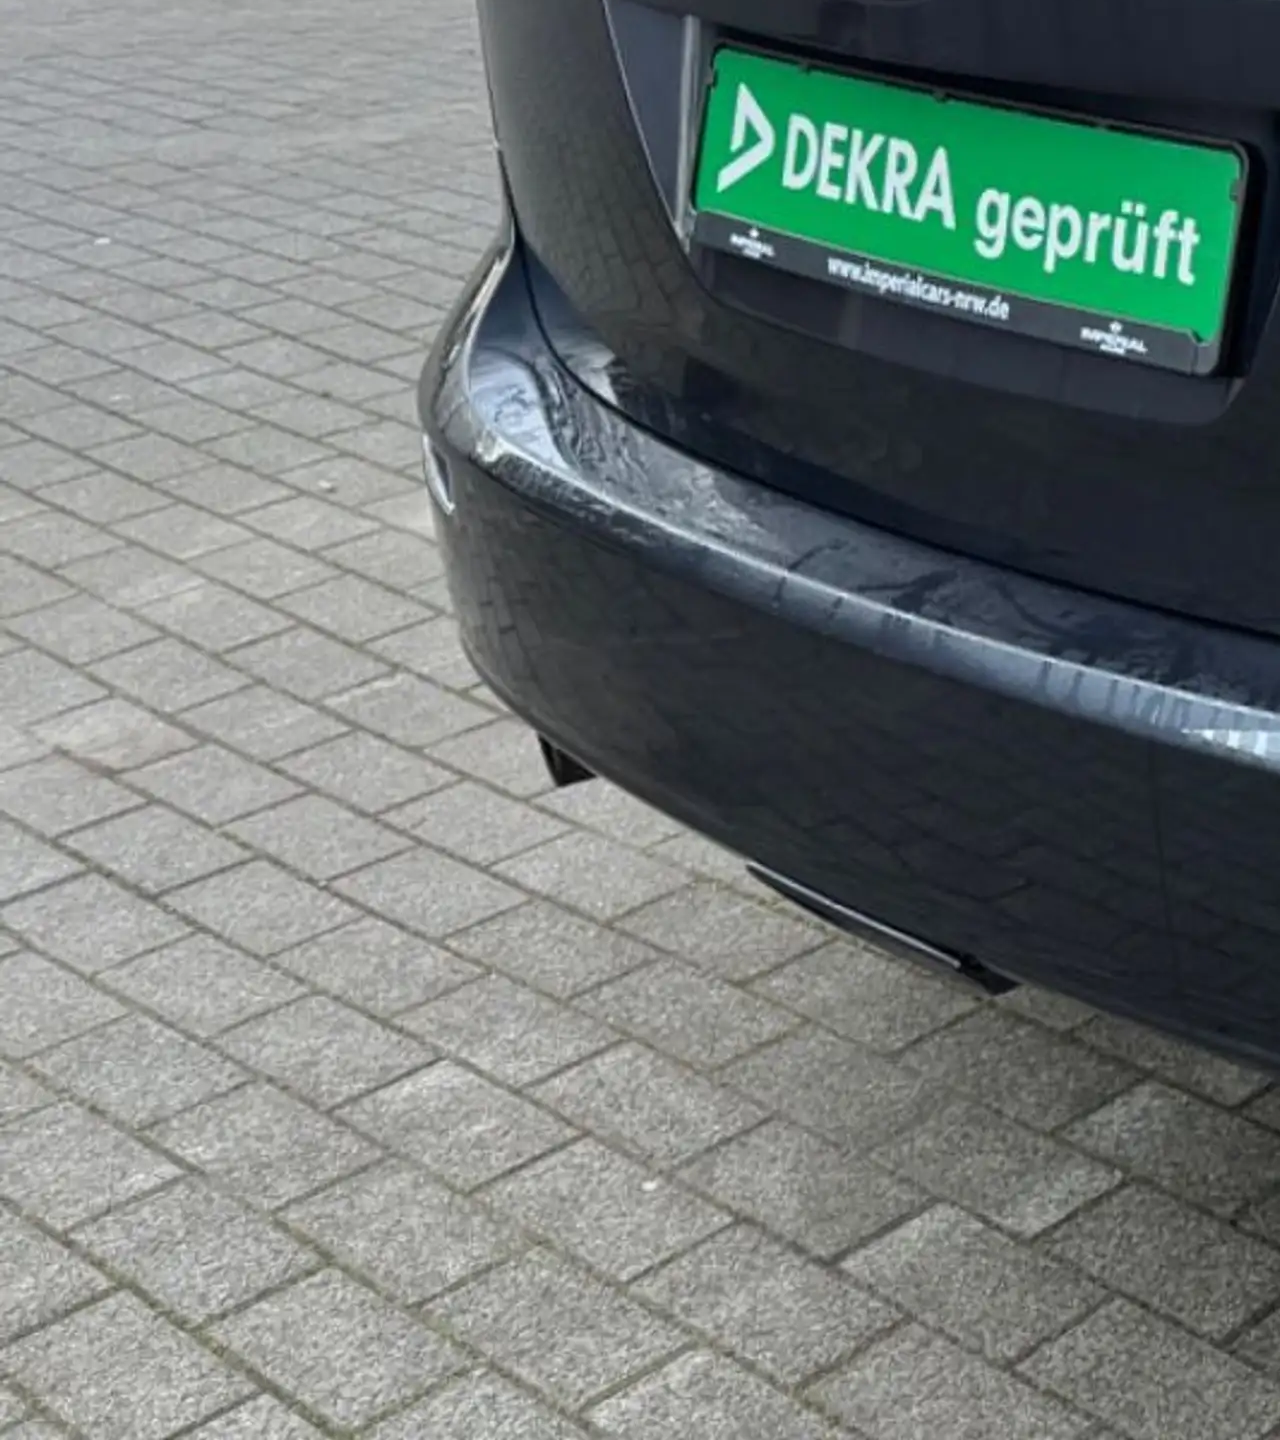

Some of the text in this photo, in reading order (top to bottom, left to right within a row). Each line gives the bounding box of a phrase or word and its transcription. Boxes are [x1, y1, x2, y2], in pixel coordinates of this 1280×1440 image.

[782, 113, 1199, 286] DEKRA geprüft
[828, 257, 1010, 320] www.imperialcars-nrw.de
